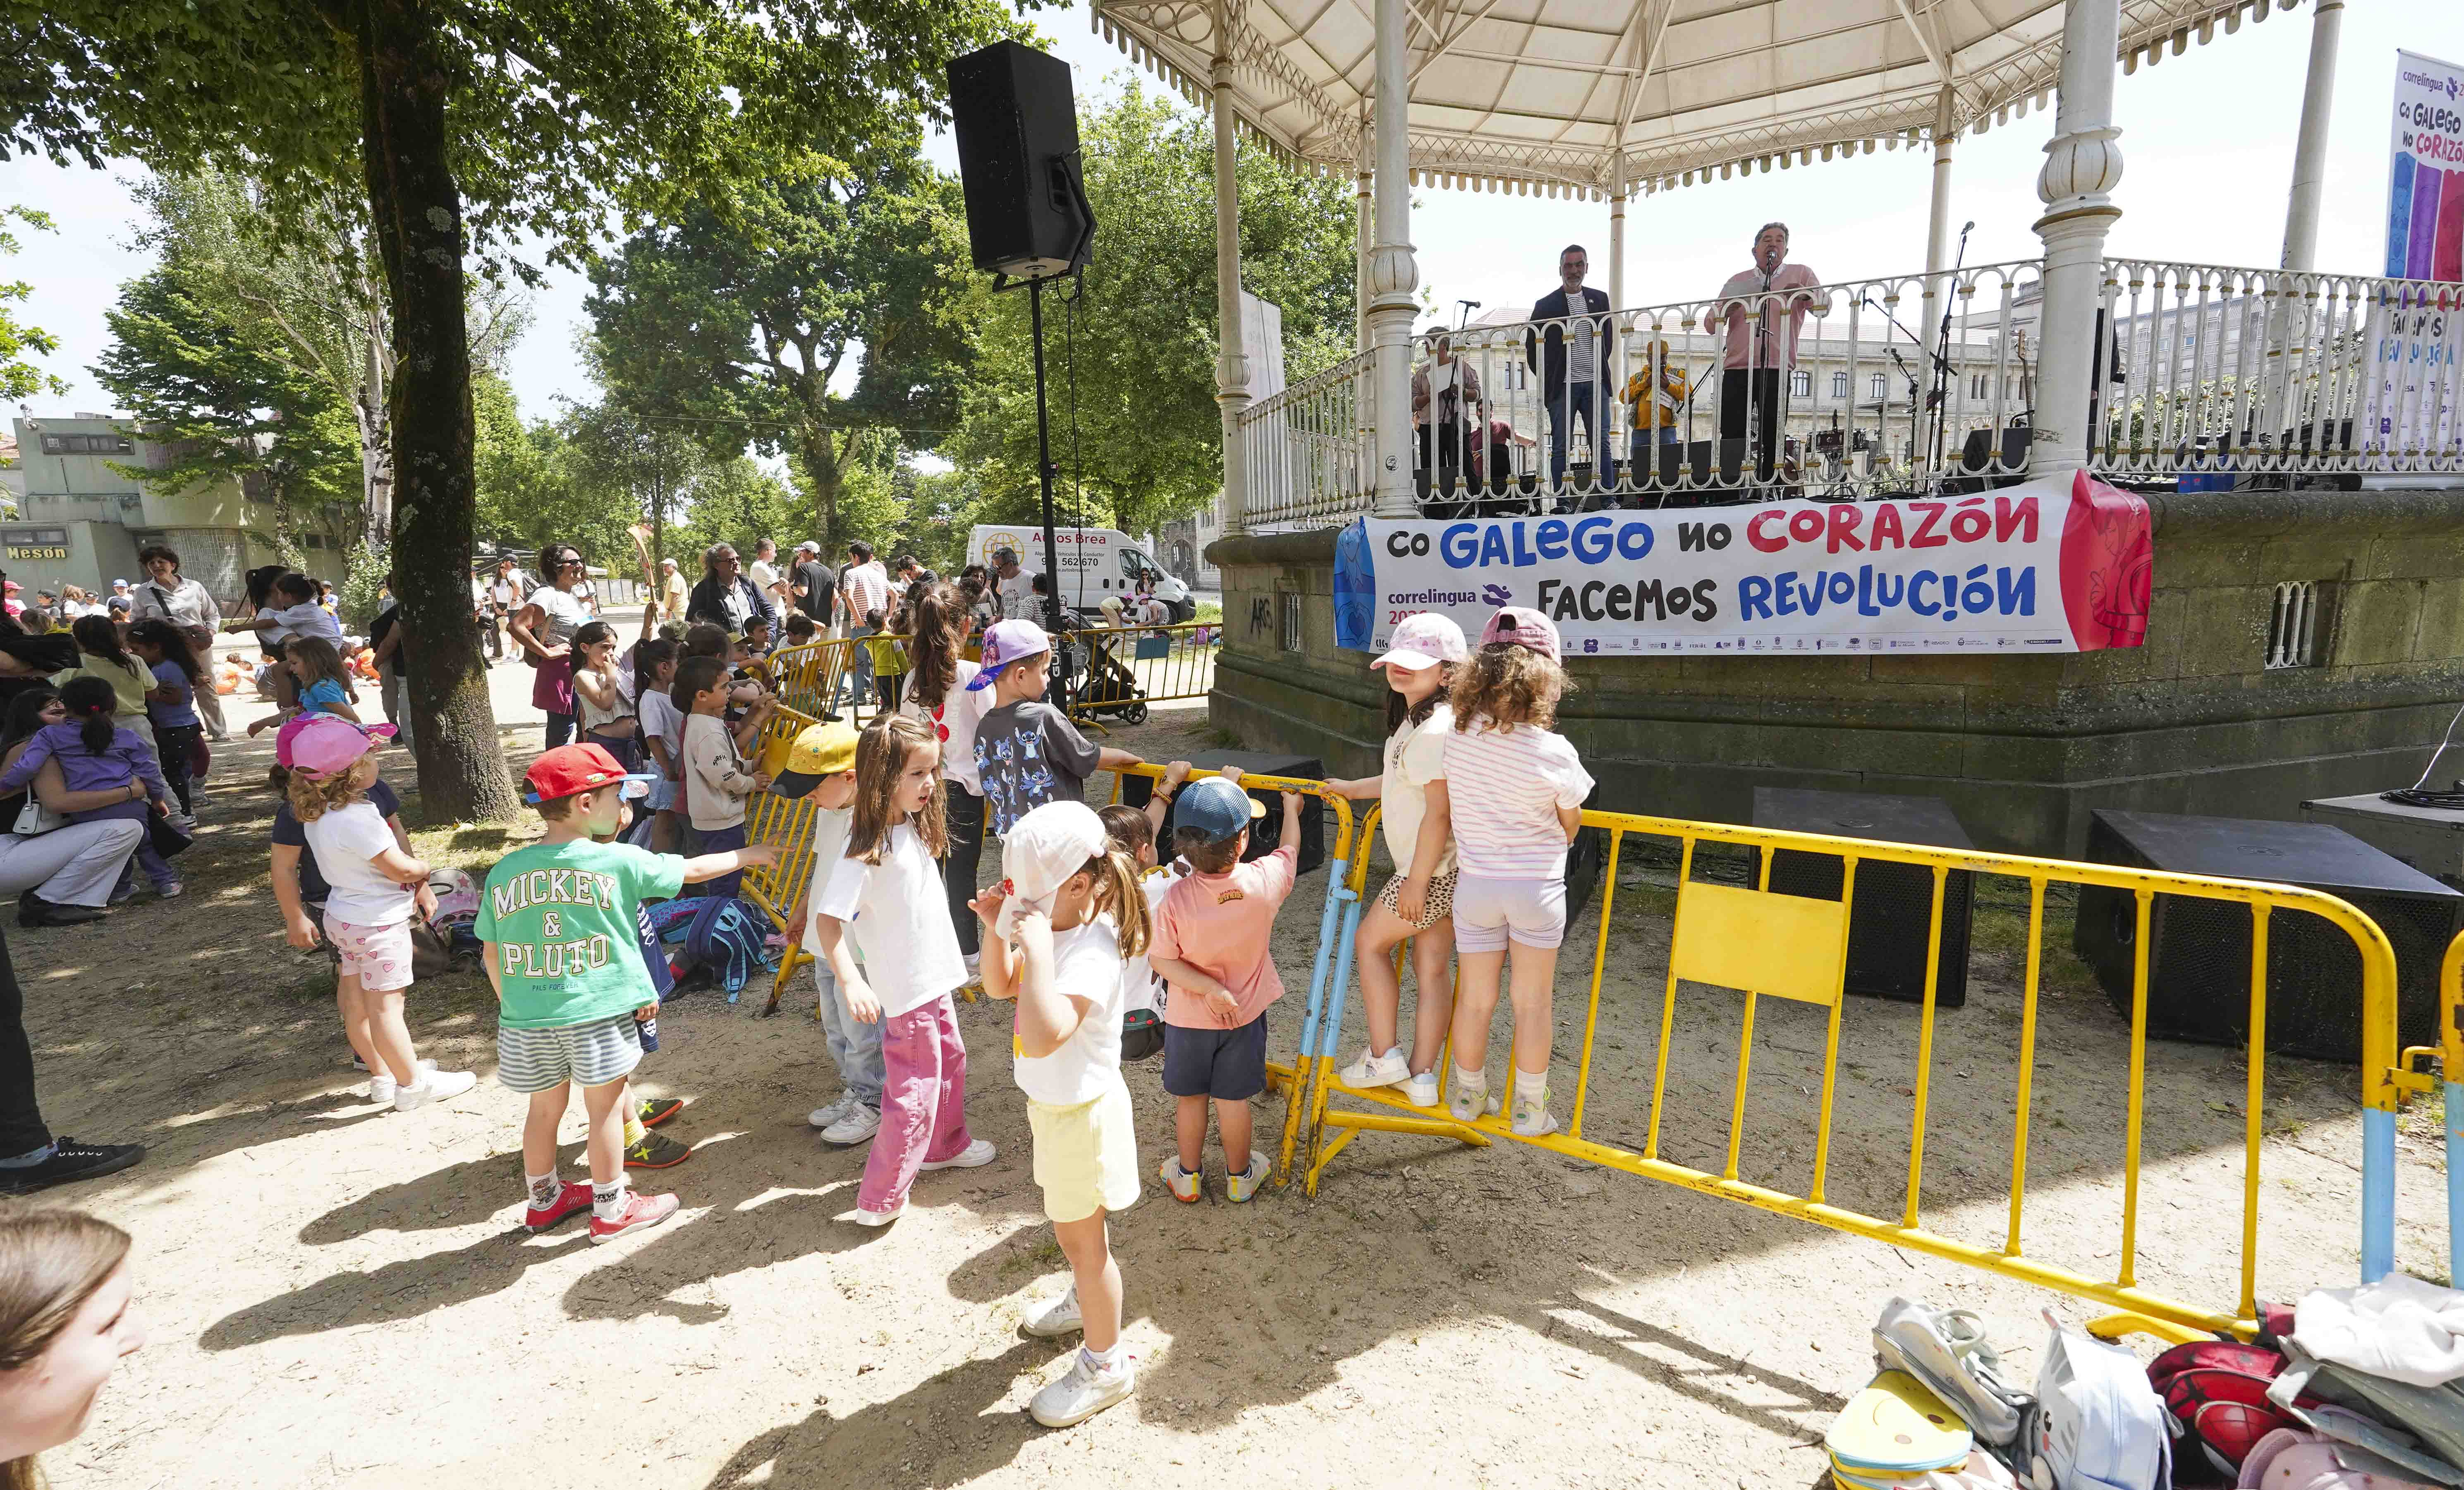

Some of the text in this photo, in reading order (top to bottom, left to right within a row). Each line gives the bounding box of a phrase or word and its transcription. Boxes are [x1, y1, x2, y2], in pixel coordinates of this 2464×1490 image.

[2403, 70, 2443, 92] correlingua
[2416, 132, 2464, 163] CORAZÓ
[1747, 496, 2039, 554] CORAZÓN
[1032, 533, 1106, 544] Aos Brea
[7, 546, 67, 559] Mesón
[1062, 558, 1098, 566] 562 670
[1388, 587, 1476, 605] correlingua
[1389, 610, 1429, 625] 20
[493, 869, 616, 921] MICKEY
[543, 911, 562, 937] &
[502, 933, 610, 977] PLUTO
[548, 982, 579, 990] FOREVER
